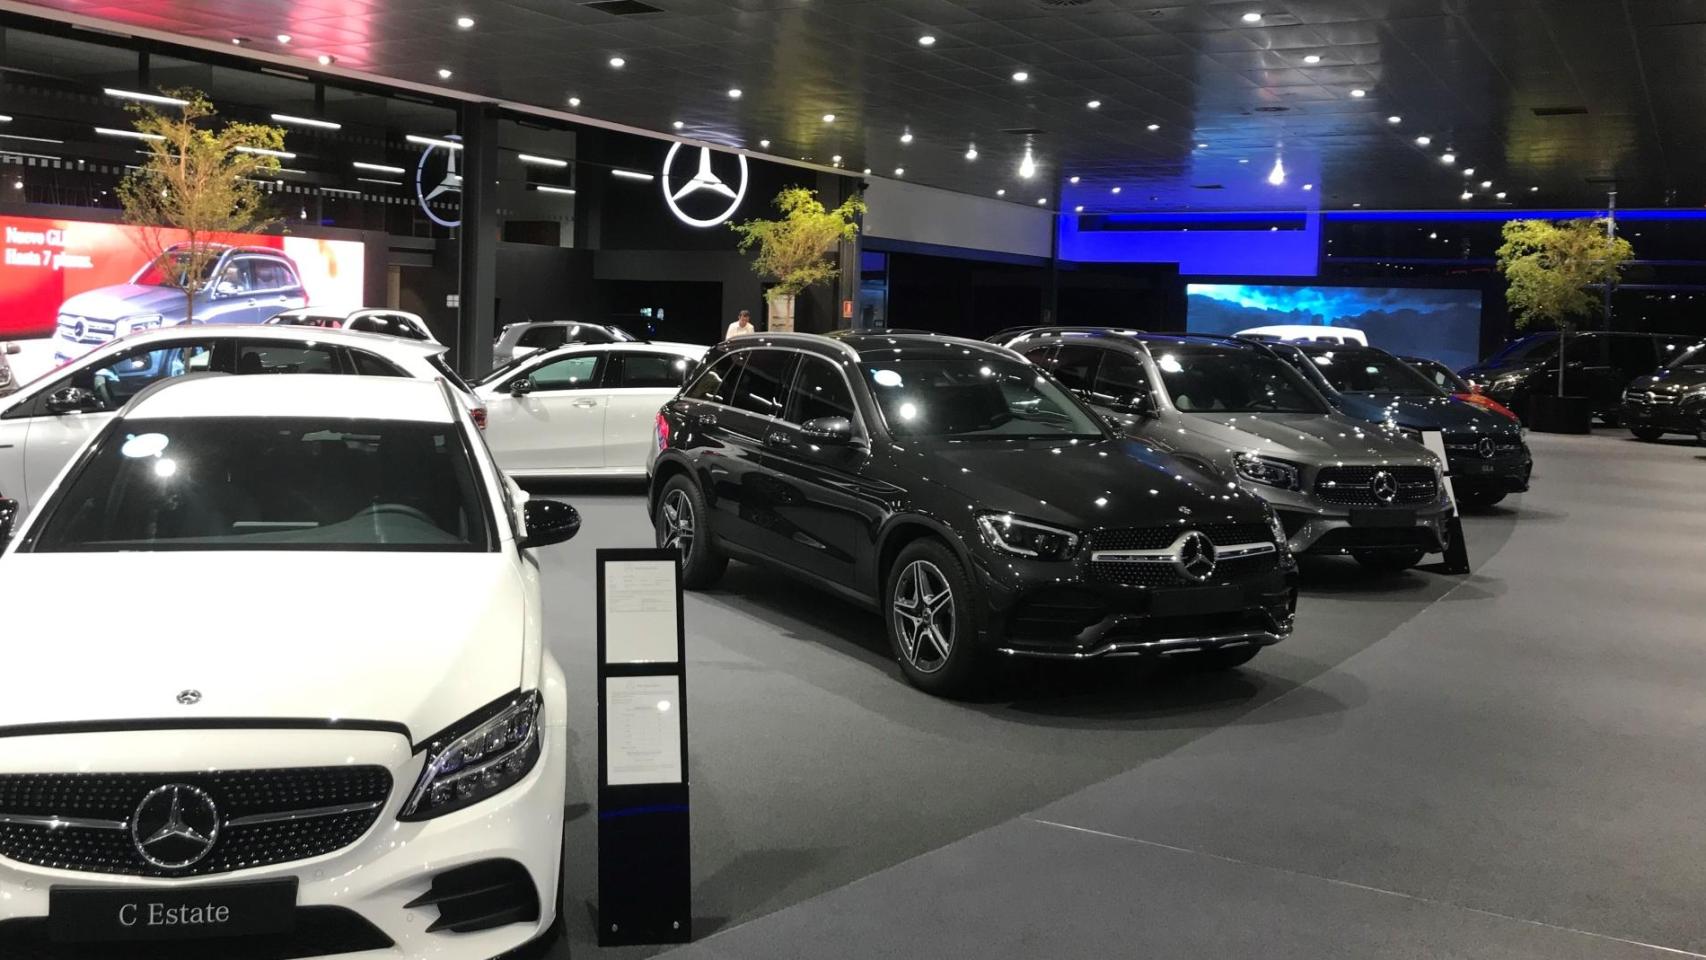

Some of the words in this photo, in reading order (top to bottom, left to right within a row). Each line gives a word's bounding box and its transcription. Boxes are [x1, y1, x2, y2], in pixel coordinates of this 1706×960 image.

[6, 227, 45, 244] Nuevo
[5, 248, 41, 266] Hasta
[43, 250, 51, 266] 7
[119, 903, 138, 926] C
[148, 902, 230, 926] Estate
